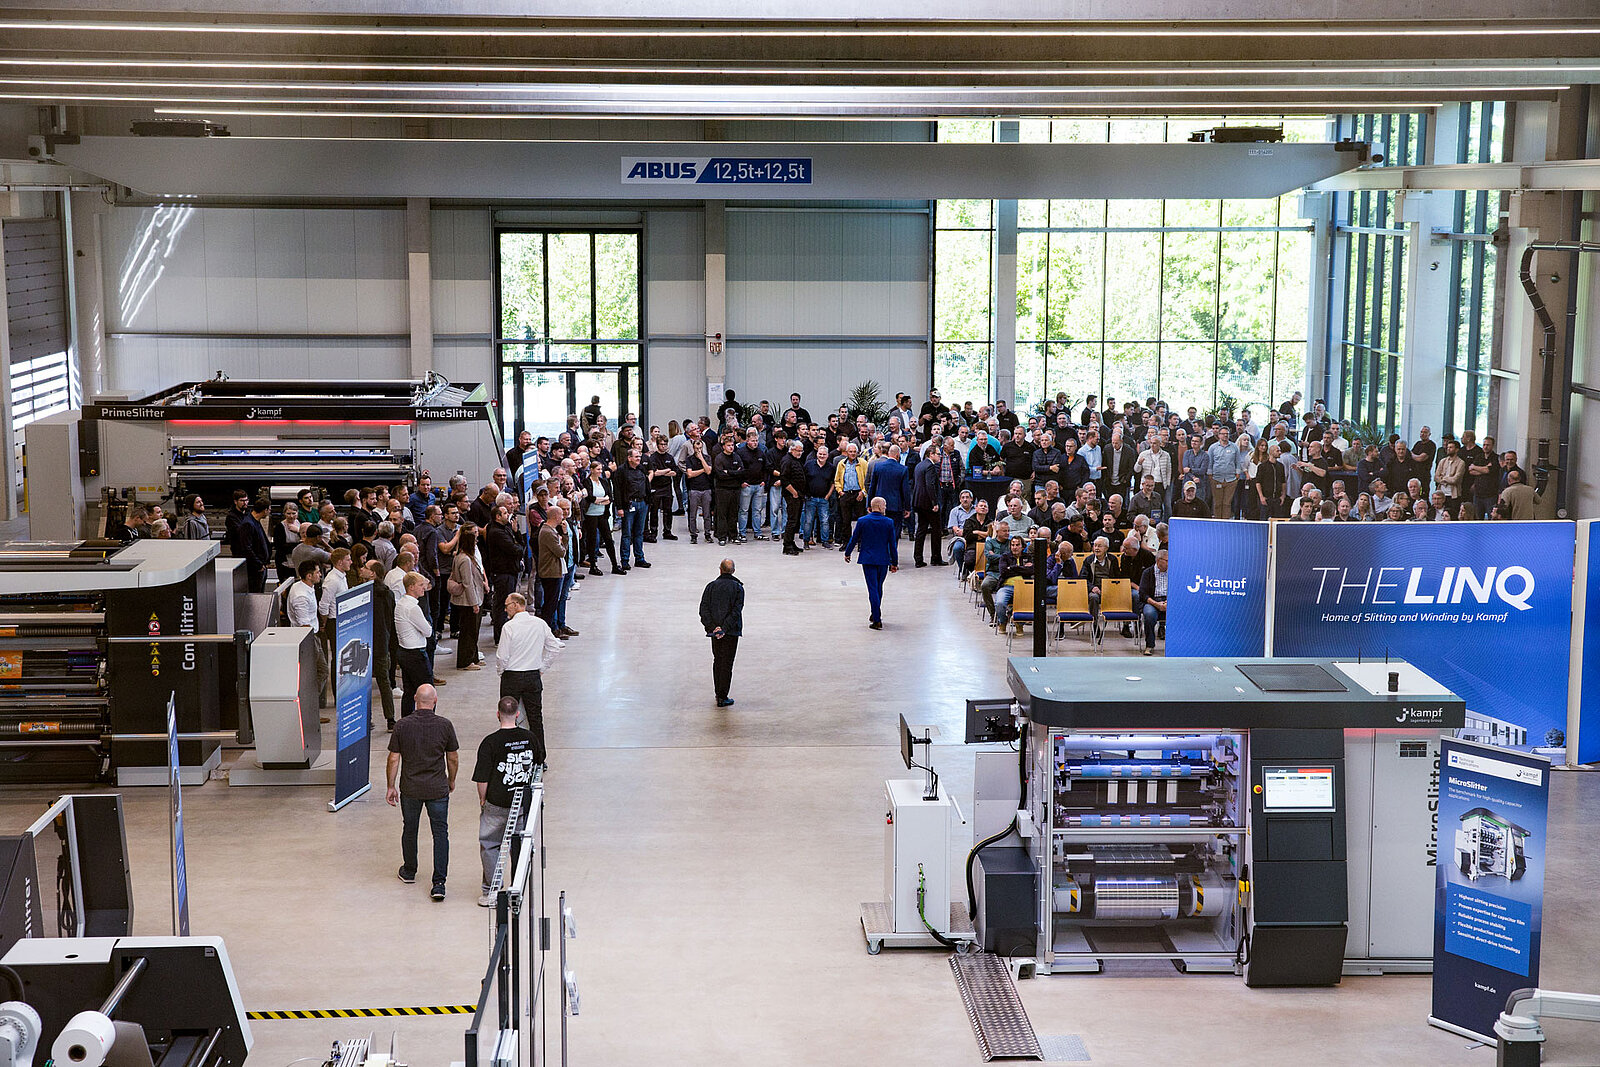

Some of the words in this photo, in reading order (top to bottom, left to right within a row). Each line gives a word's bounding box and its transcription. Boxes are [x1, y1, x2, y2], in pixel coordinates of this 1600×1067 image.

[627, 162, 697, 179] ABUS
[713, 162, 805, 182] 12,5t+12,5t
[101, 407, 165, 418] PrimeSlitter
[257, 407, 282, 417] kampf
[415, 408, 478, 418] PrimeSlitter
[1205, 575, 1247, 591] kampf
[1312, 567, 1404, 605] THE
[1403, 565, 1536, 611] LINQ
[1321, 613, 1350, 622] Home
[1351, 612, 1363, 624] of
[1363, 612, 1397, 624] Slitting
[1399, 612, 1419, 622] and
[1420, 612, 1459, 624] Winding
[1460, 612, 1474, 624] by
[1475, 611, 1509, 623] Kampf
[180, 595, 195, 671] Conlitter
[1410, 707, 1443, 719] kampf
[1448, 776, 1488, 792] MicroSlitter
[1456, 788, 1476, 798] benchmark
[1459, 893, 1474, 902] Highest
[1474, 898, 1489, 907] slitting
[1489, 902, 1507, 911] precision
[1458, 903, 1473, 911] Proven
[1472, 907, 1491, 916] expertise
[1497, 914, 1517, 924] capacitor
[1458, 912, 1474, 921] Reliable
[1473, 917, 1490, 926] process
[1489, 921, 1506, 931] stability
[1457, 921, 1473, 930] Flexible
[1473, 927, 1495, 937] production
[1494, 933, 1513, 942] solutions
[1457, 930, 1476, 940] Sensitive
[1475, 936, 1498, 947] direct-drive
[1497, 943, 1521, 955] technology
[1474, 981, 1497, 994] kampf.de
